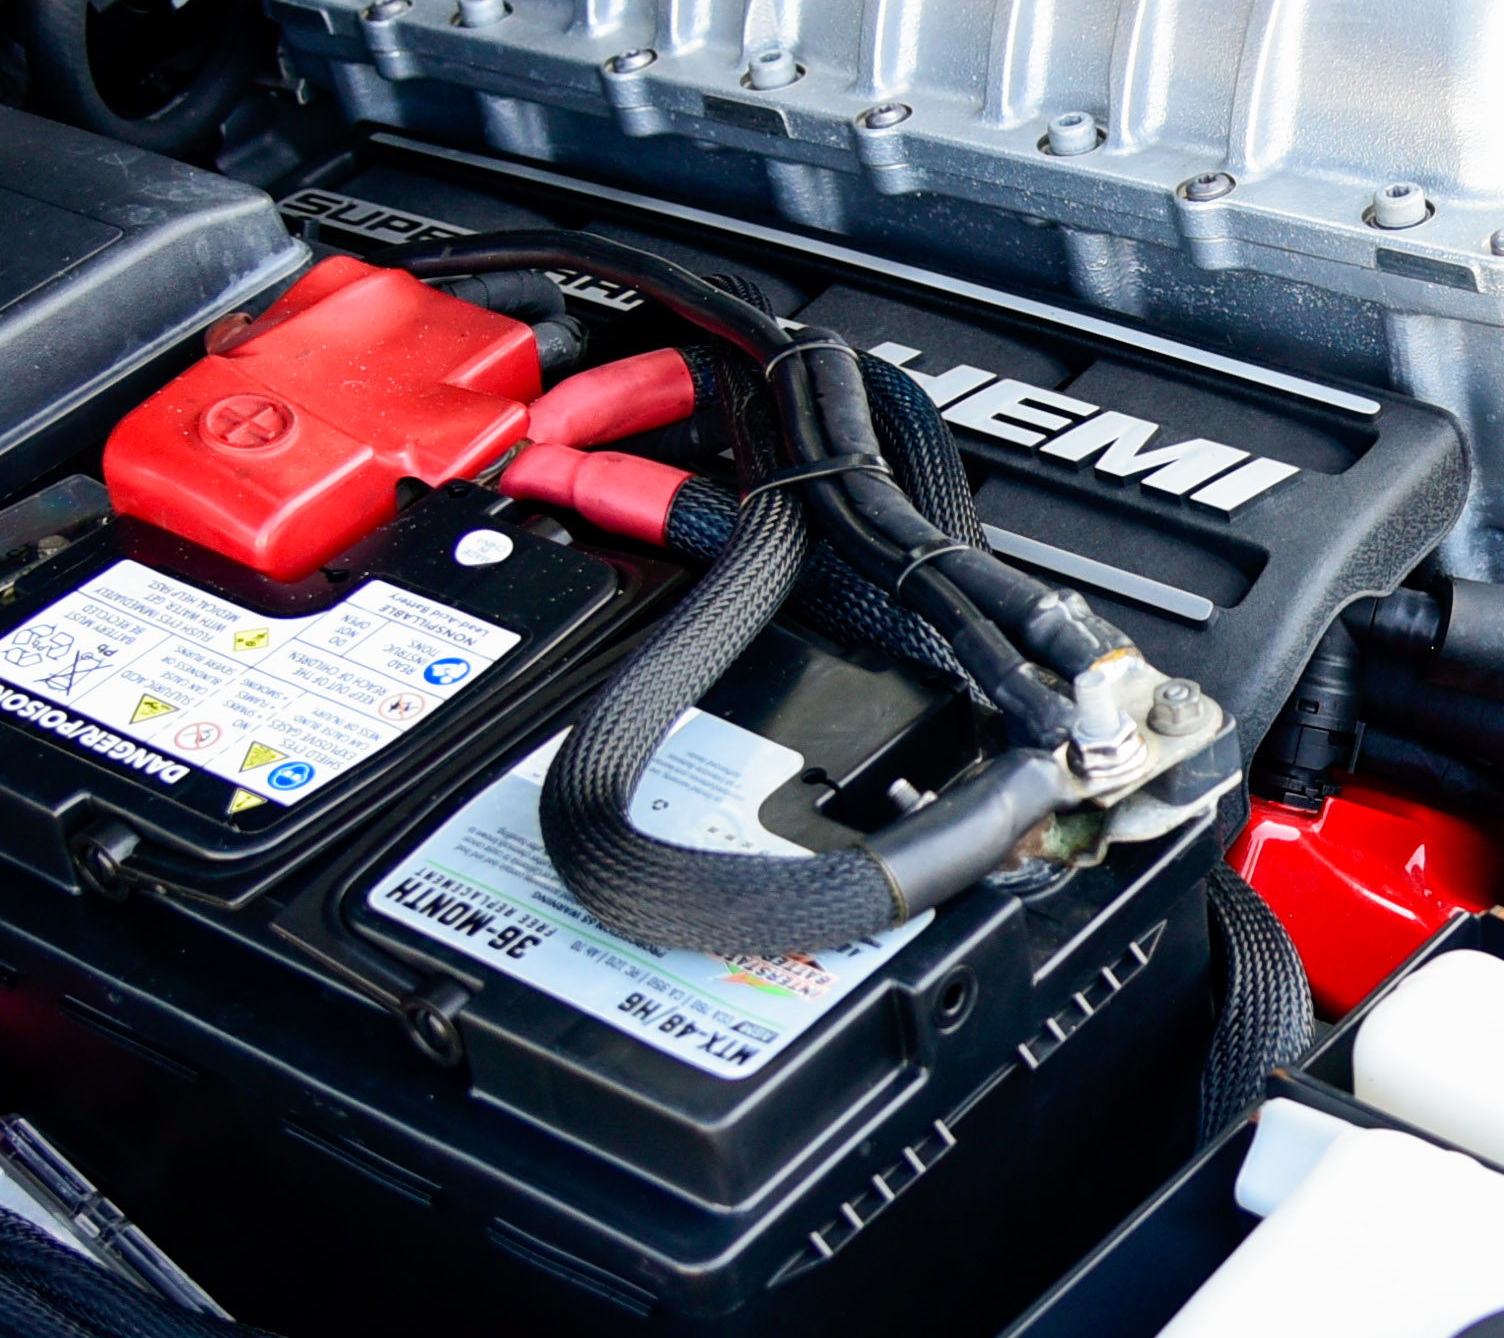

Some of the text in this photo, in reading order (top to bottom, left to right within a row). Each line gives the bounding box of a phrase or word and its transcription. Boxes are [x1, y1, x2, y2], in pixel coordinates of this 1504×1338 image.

[862, 339, 1301, 515] HEMI
[142, 592, 166, 605] GET
[169, 589, 199, 604] HELP
[79, 603, 146, 635] BE RECYCLED
[92, 585, 215, 642] FLUSH EYES IMMEDIATELY
[194, 599, 241, 622] MEDICAL
[388, 592, 489, 636] Lead-Acid Battery
[62, 609, 137, 645] BATTERY MUST
[196, 617, 228, 632] WITH
[333, 625, 360, 638] NOT
[377, 604, 477, 646] NONSPILLABLE
[325, 635, 348, 647] DO
[159, 654, 223, 685] BLINDNESS OR
[202, 658, 237, 675] SEVERE
[335, 671, 356, 682] OF
[383, 658, 418, 675] READ
[119, 668, 195, 706] SULFURIC ACID
[159, 670, 210, 695] CAN CAUSE
[239, 677, 285, 699] SMOKING
[290, 666, 376, 705] KEEP OUT OF THE
[350, 677, 389, 696] REACH
[222, 699, 259, 716] SPARKS
[233, 690, 271, 708] FLAMES
[230, 717, 252, 730] NO
[318, 725, 352, 743] CAUSE
[342, 720, 361, 731] OR
[356, 726, 384, 741] NESS
[266, 718, 359, 760] EXPLOSIVE GASES
[347, 738, 372, 751] CAN
[303, 748, 346, 770] SHIELD
[410, 865, 559, 937] FREE REPLACEMENT
[529, 890, 584, 919] WARNING
[382, 876, 545, 959] 36-MONTH
[613, 989, 760, 1066] MTX-48/H6
